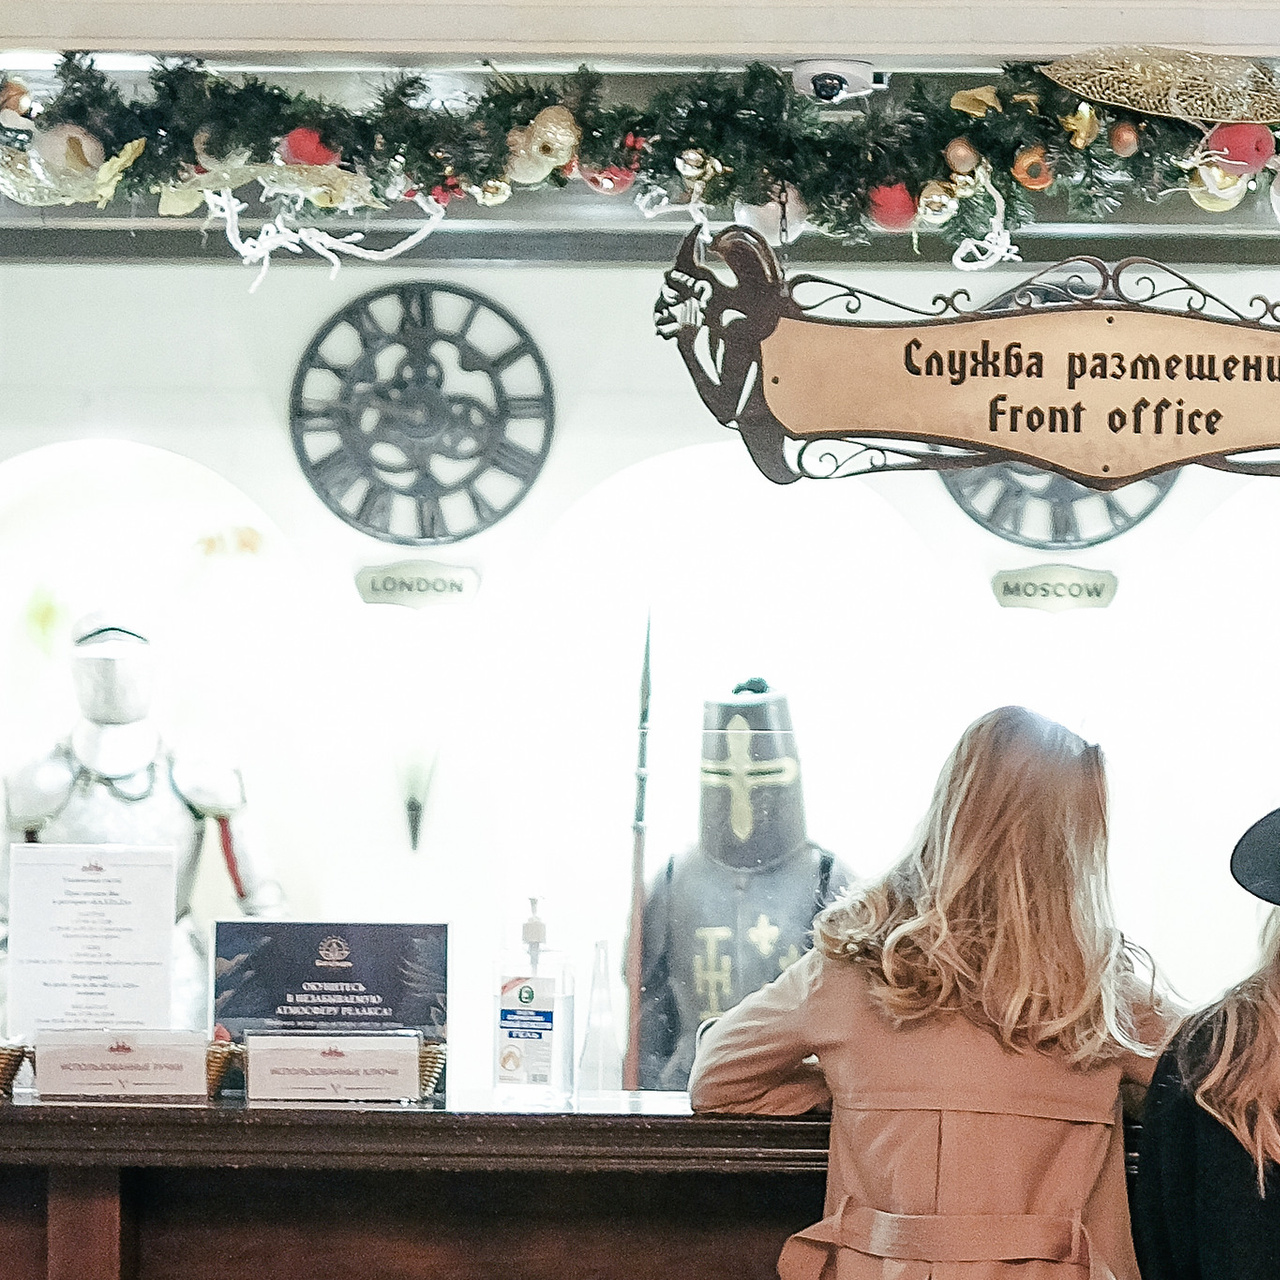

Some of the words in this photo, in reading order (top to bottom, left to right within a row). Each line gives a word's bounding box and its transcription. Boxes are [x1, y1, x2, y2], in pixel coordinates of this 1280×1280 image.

[903, 338, 1044, 385] Служба
[1107, 396, 1224, 435] office
[370, 576, 463, 593] LONDON
[1002, 581, 1105, 598] MOSCOW
